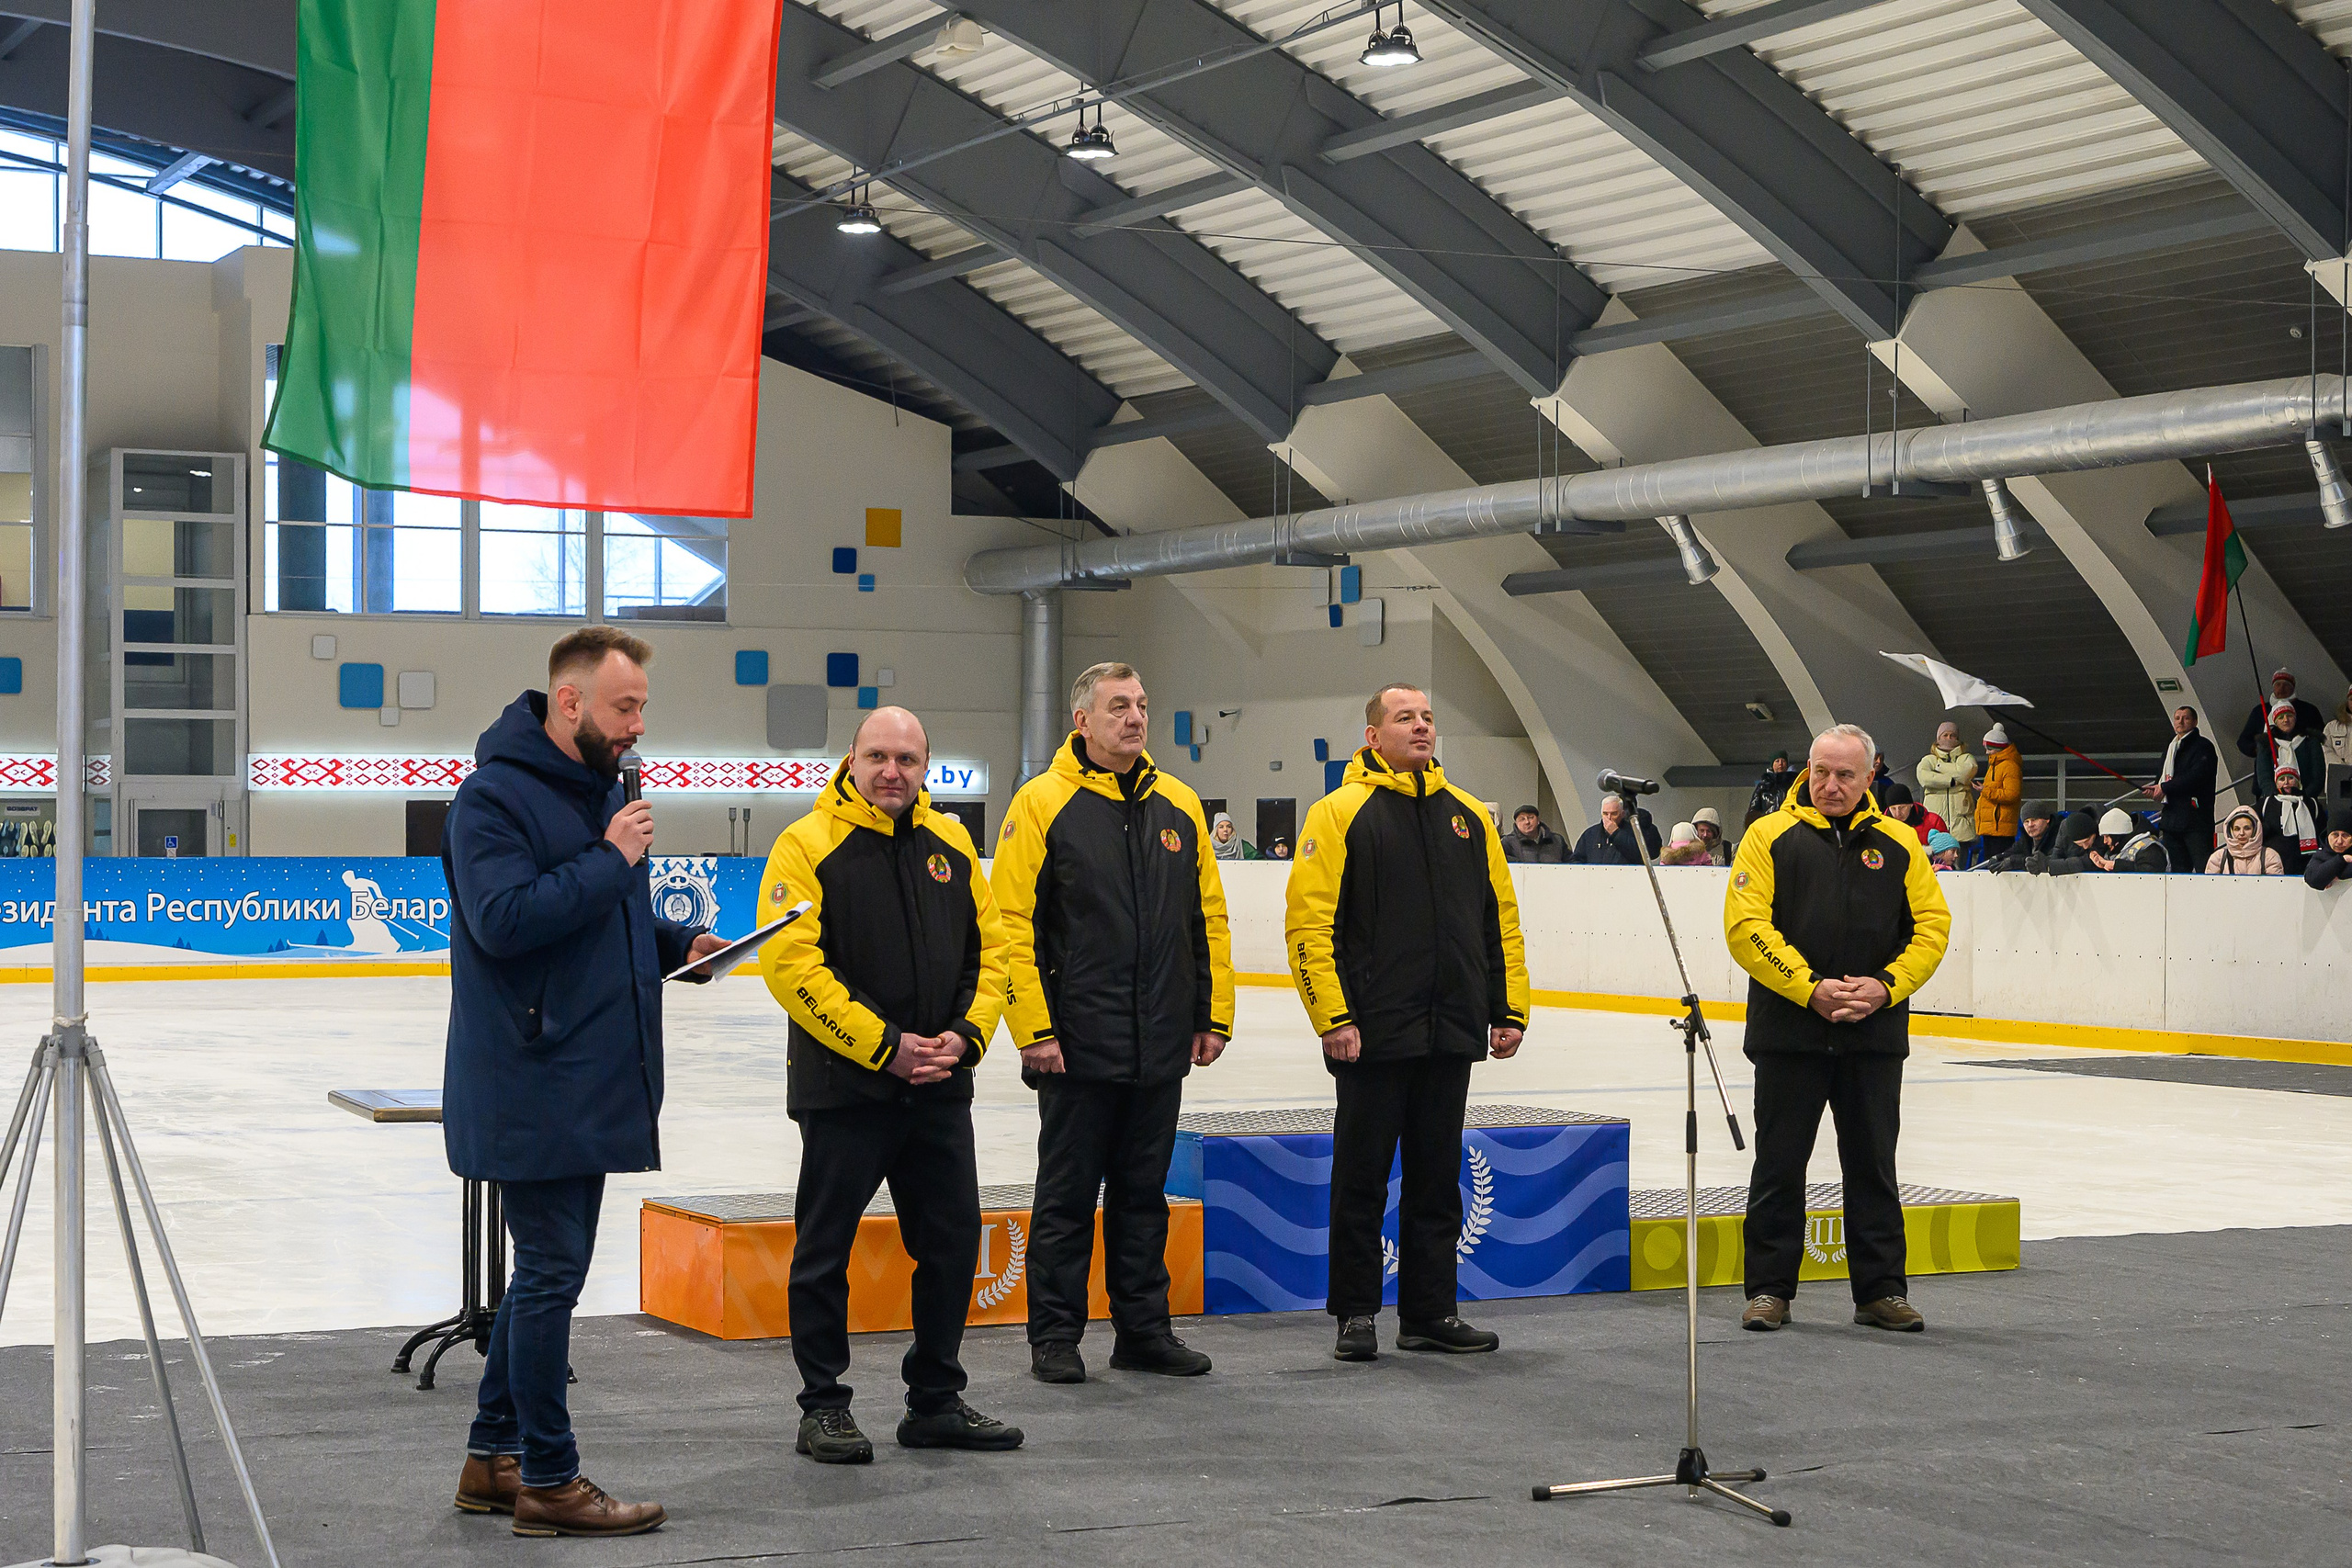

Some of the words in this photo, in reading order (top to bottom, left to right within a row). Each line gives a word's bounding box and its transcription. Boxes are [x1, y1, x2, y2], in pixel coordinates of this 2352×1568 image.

[0, 900, 136, 929] зиднта
[147, 891, 340, 930] Республики
[351, 891, 451, 928] Белар
[1297, 942, 1317, 1006] BELARUS
[1749, 932, 1794, 979] BELARUS
[797, 987, 857, 1047] BELARUS
